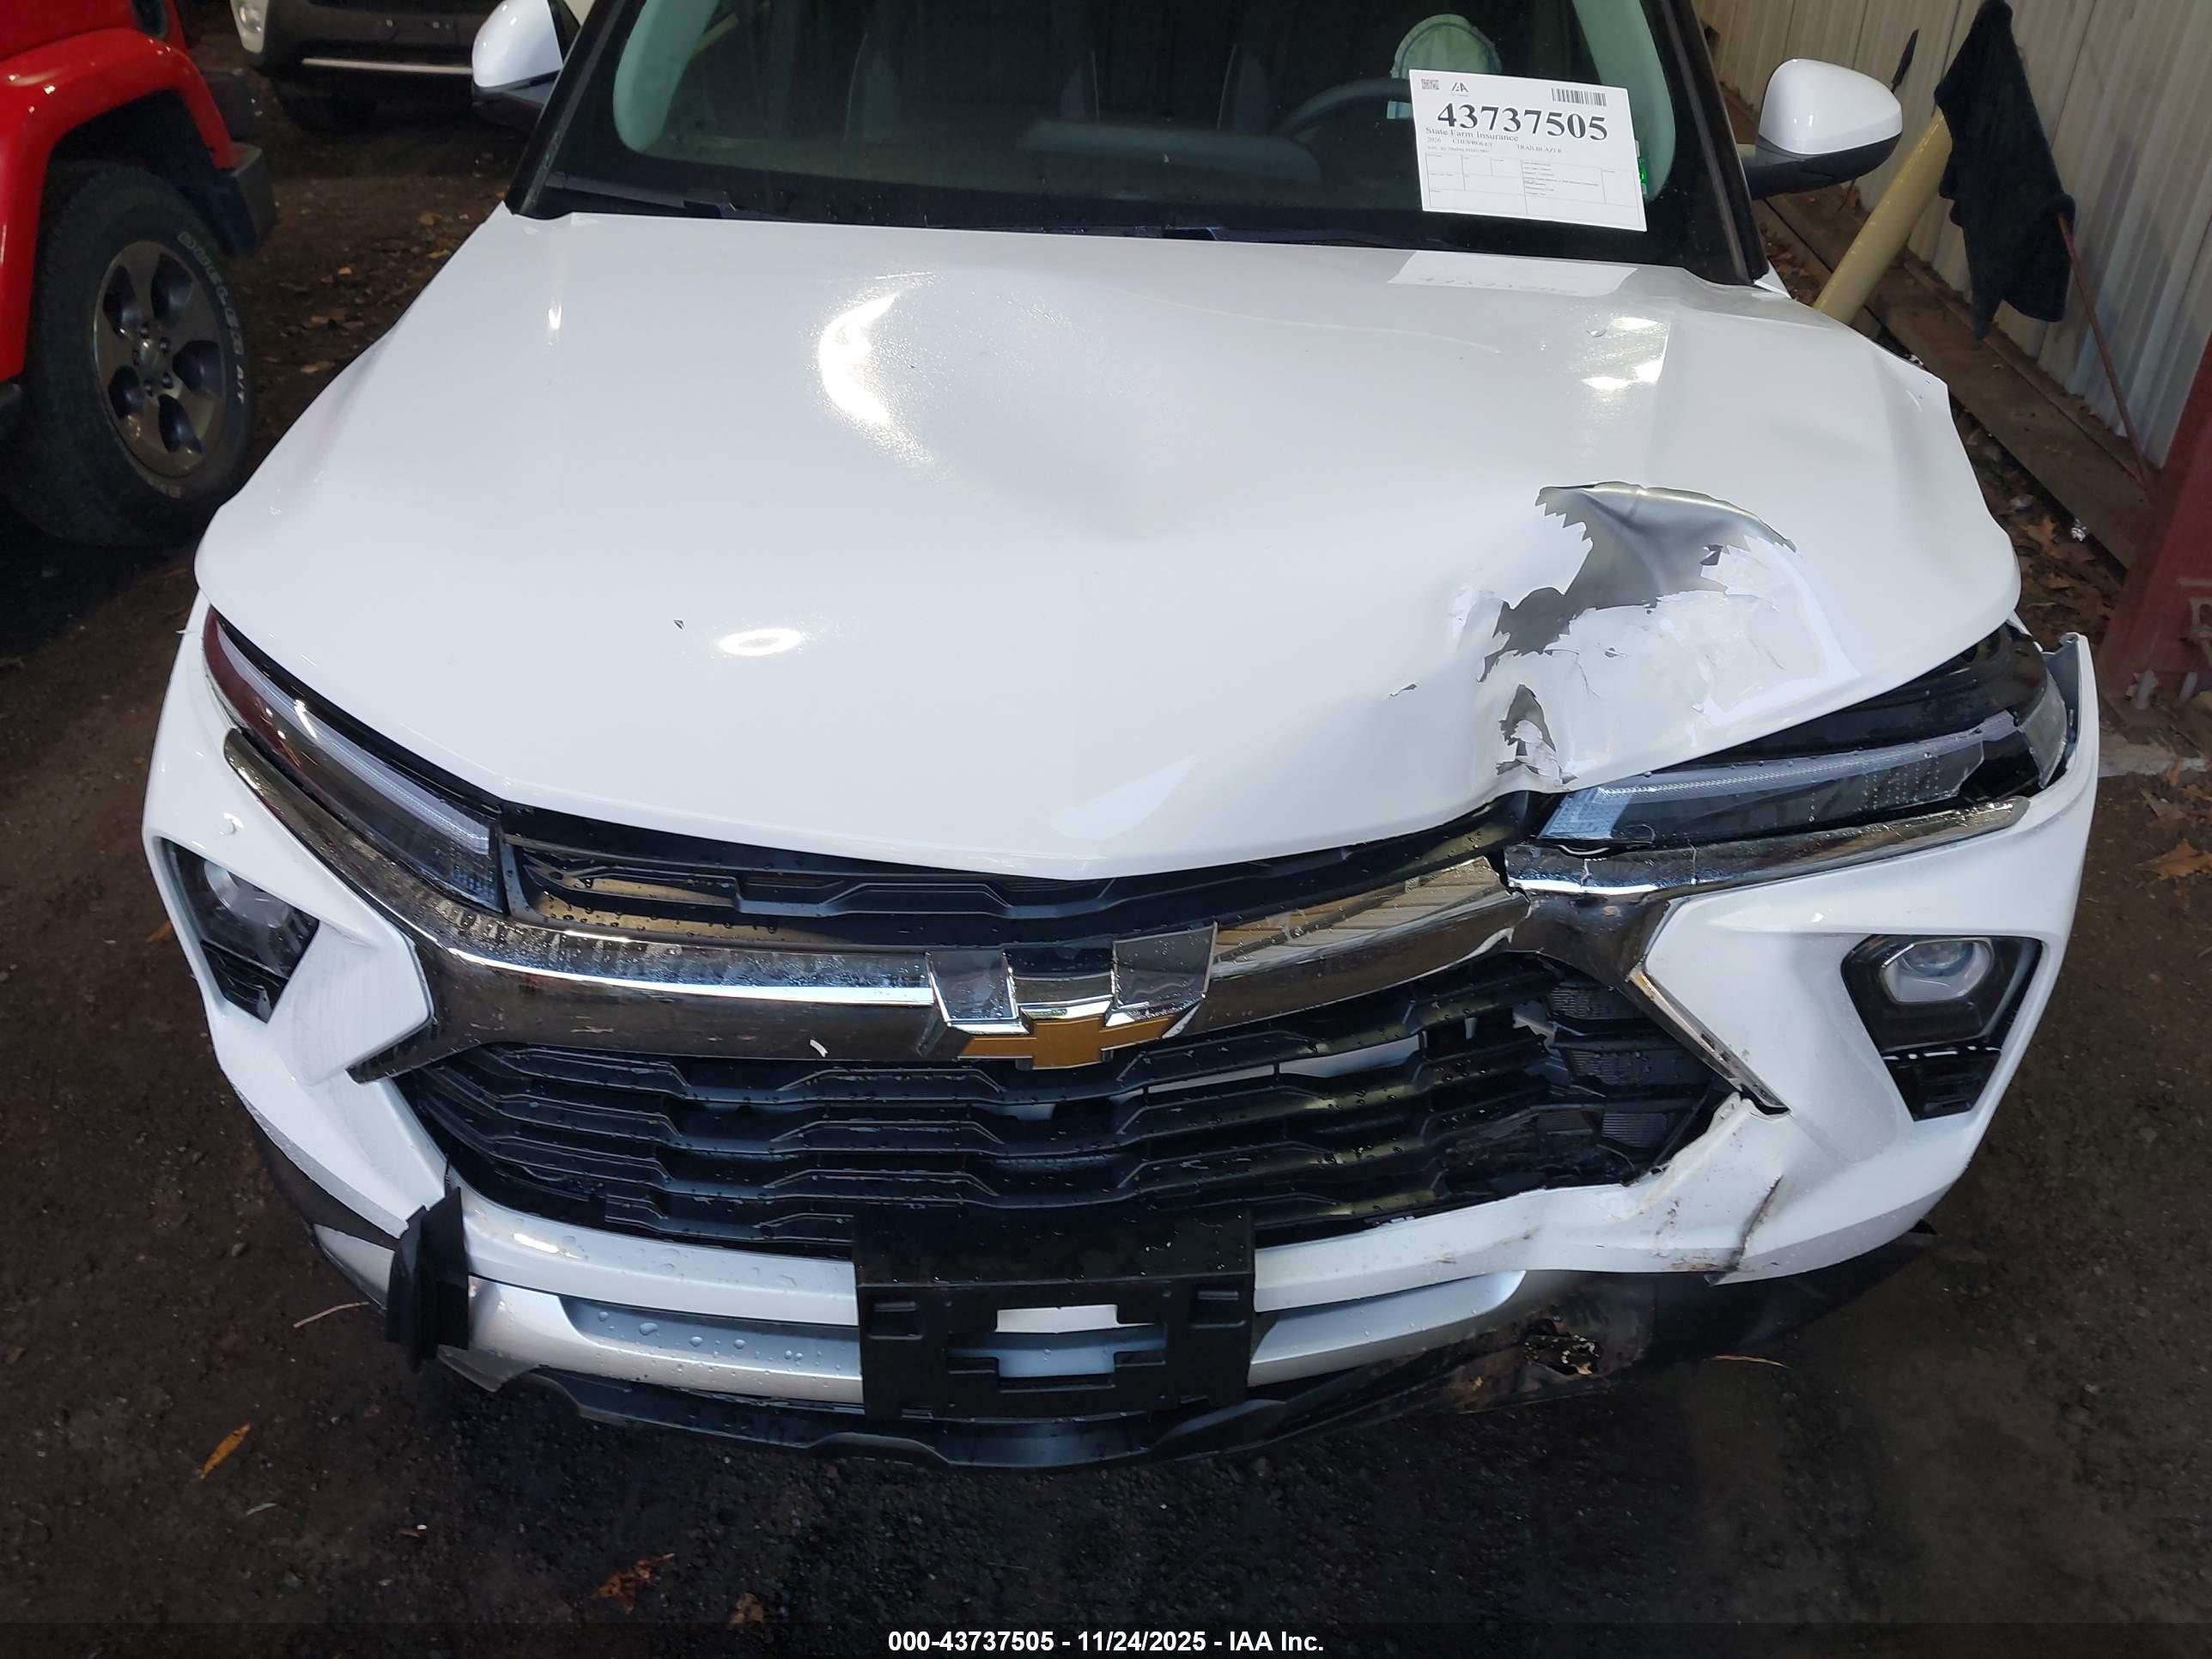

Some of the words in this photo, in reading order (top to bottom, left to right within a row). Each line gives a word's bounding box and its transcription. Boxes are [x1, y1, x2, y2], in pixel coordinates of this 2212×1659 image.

[1425, 127, 1449, 136] State
[1450, 129, 1474, 138] Farm
[1477, 131, 1519, 142] Insurance
[1437, 102, 1607, 141] 43737505
